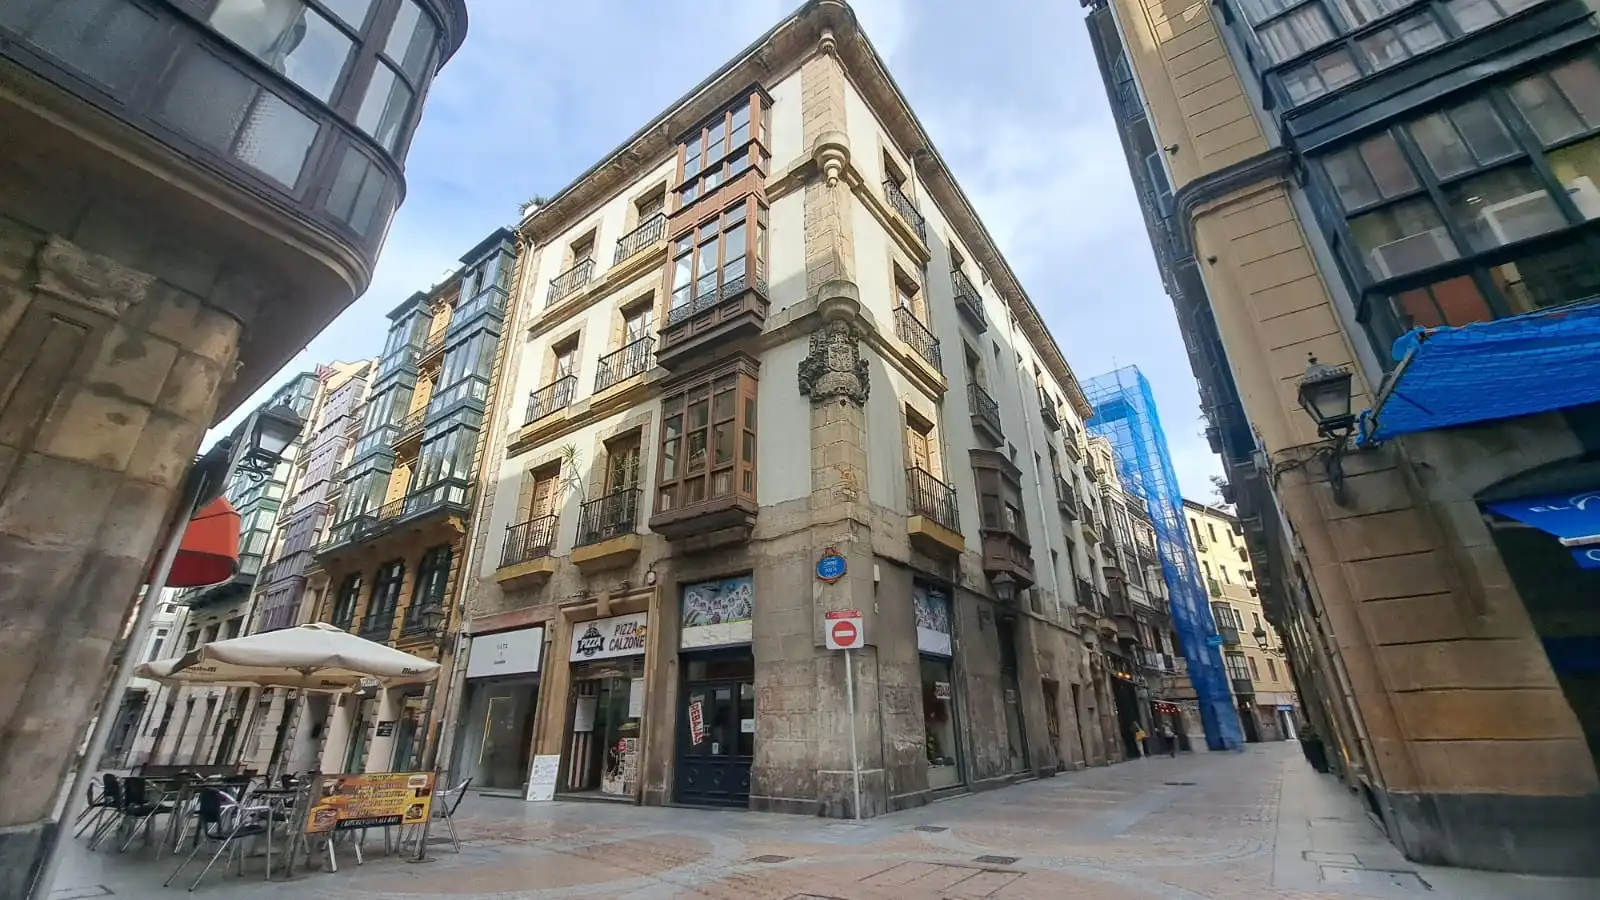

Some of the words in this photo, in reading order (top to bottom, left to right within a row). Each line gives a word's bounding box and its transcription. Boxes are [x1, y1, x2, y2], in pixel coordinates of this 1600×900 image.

[614, 621, 638, 636] PIZZA
[580, 638, 601, 649] PIZZA
[609, 635, 645, 651] CALZONE
